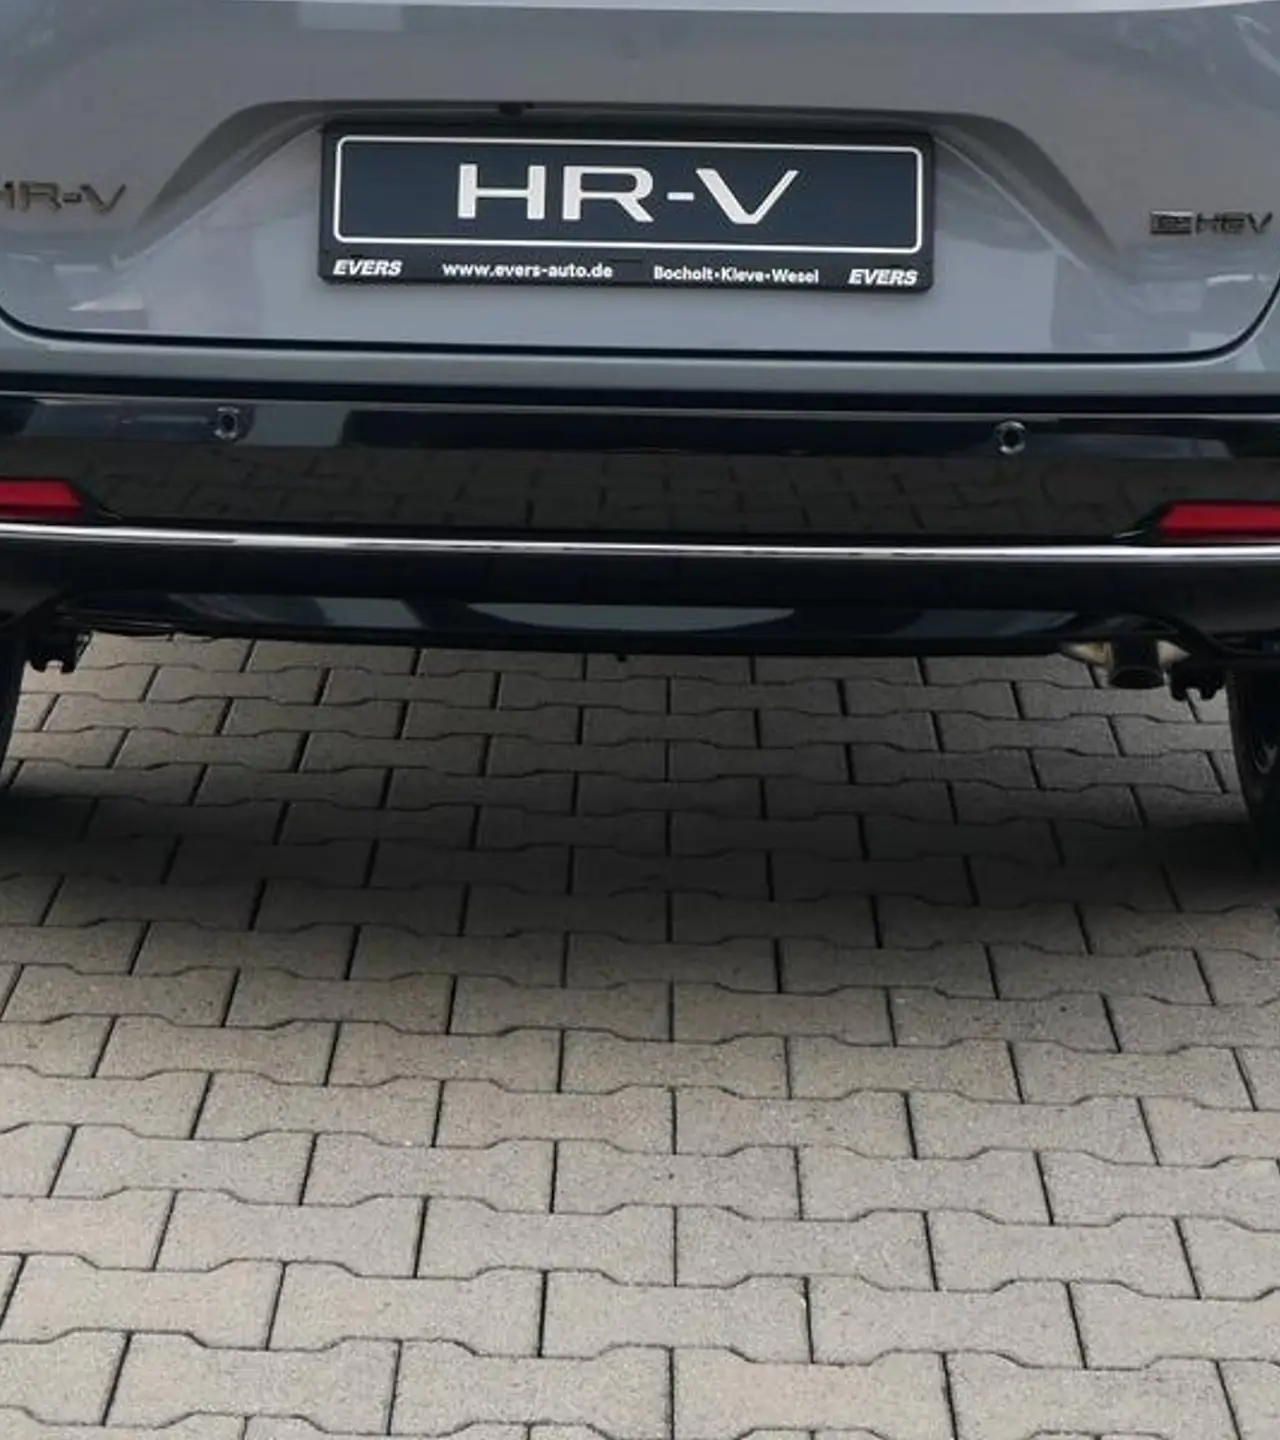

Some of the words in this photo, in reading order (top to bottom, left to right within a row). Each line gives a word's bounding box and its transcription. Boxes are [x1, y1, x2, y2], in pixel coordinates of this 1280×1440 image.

[458, 163, 800, 225] HR-V
[332, 258, 403, 277] EVERS
[441, 262, 614, 279] www.evers-auto.de
[847, 268, 918, 286] EVERS
